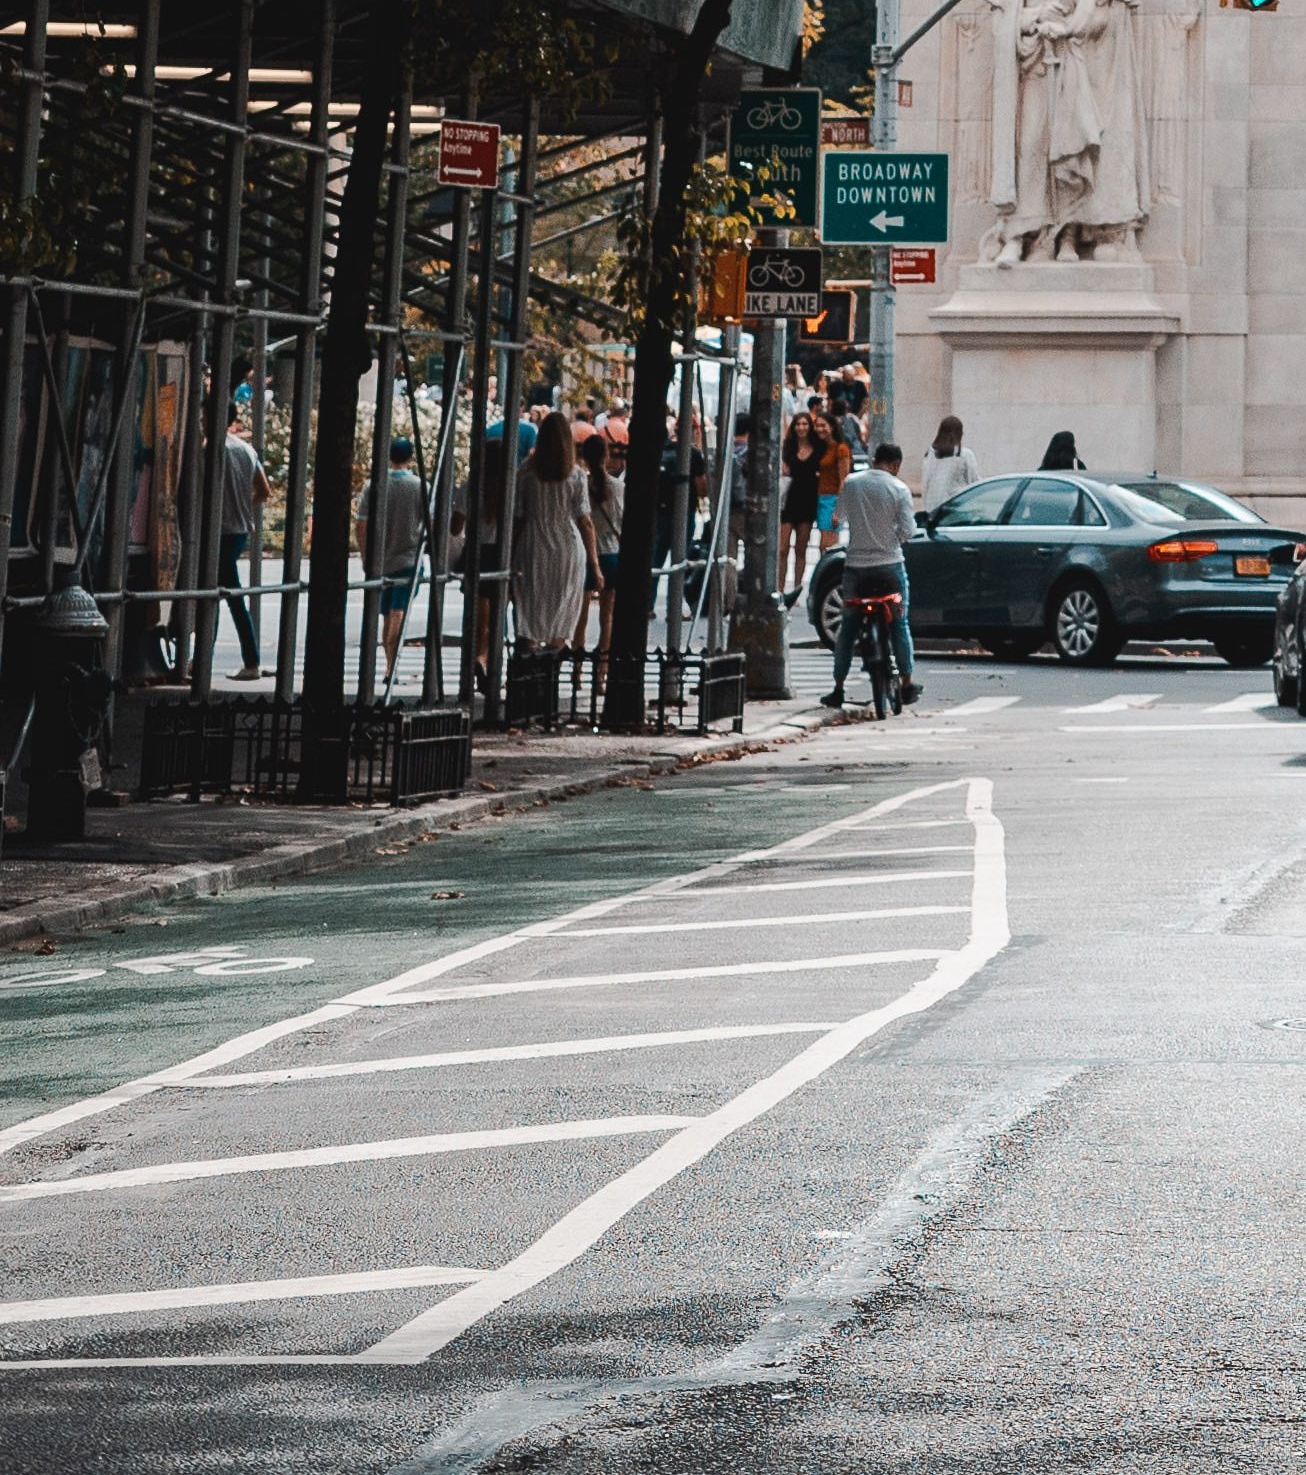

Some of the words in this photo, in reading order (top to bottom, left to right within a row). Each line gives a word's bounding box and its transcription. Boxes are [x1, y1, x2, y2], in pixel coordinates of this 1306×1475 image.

[443, 126, 455, 140] NO
[456, 127, 490, 143] STOPPING
[831, 127, 866, 142] NORTH
[443, 141, 473, 156] Anytime
[734, 143, 766, 158] Best
[771, 143, 813, 158] Route
[838, 163, 933, 181] BROADWAY
[837, 186, 936, 204] DOWNTOWN
[776, 295, 817, 314] LANE
